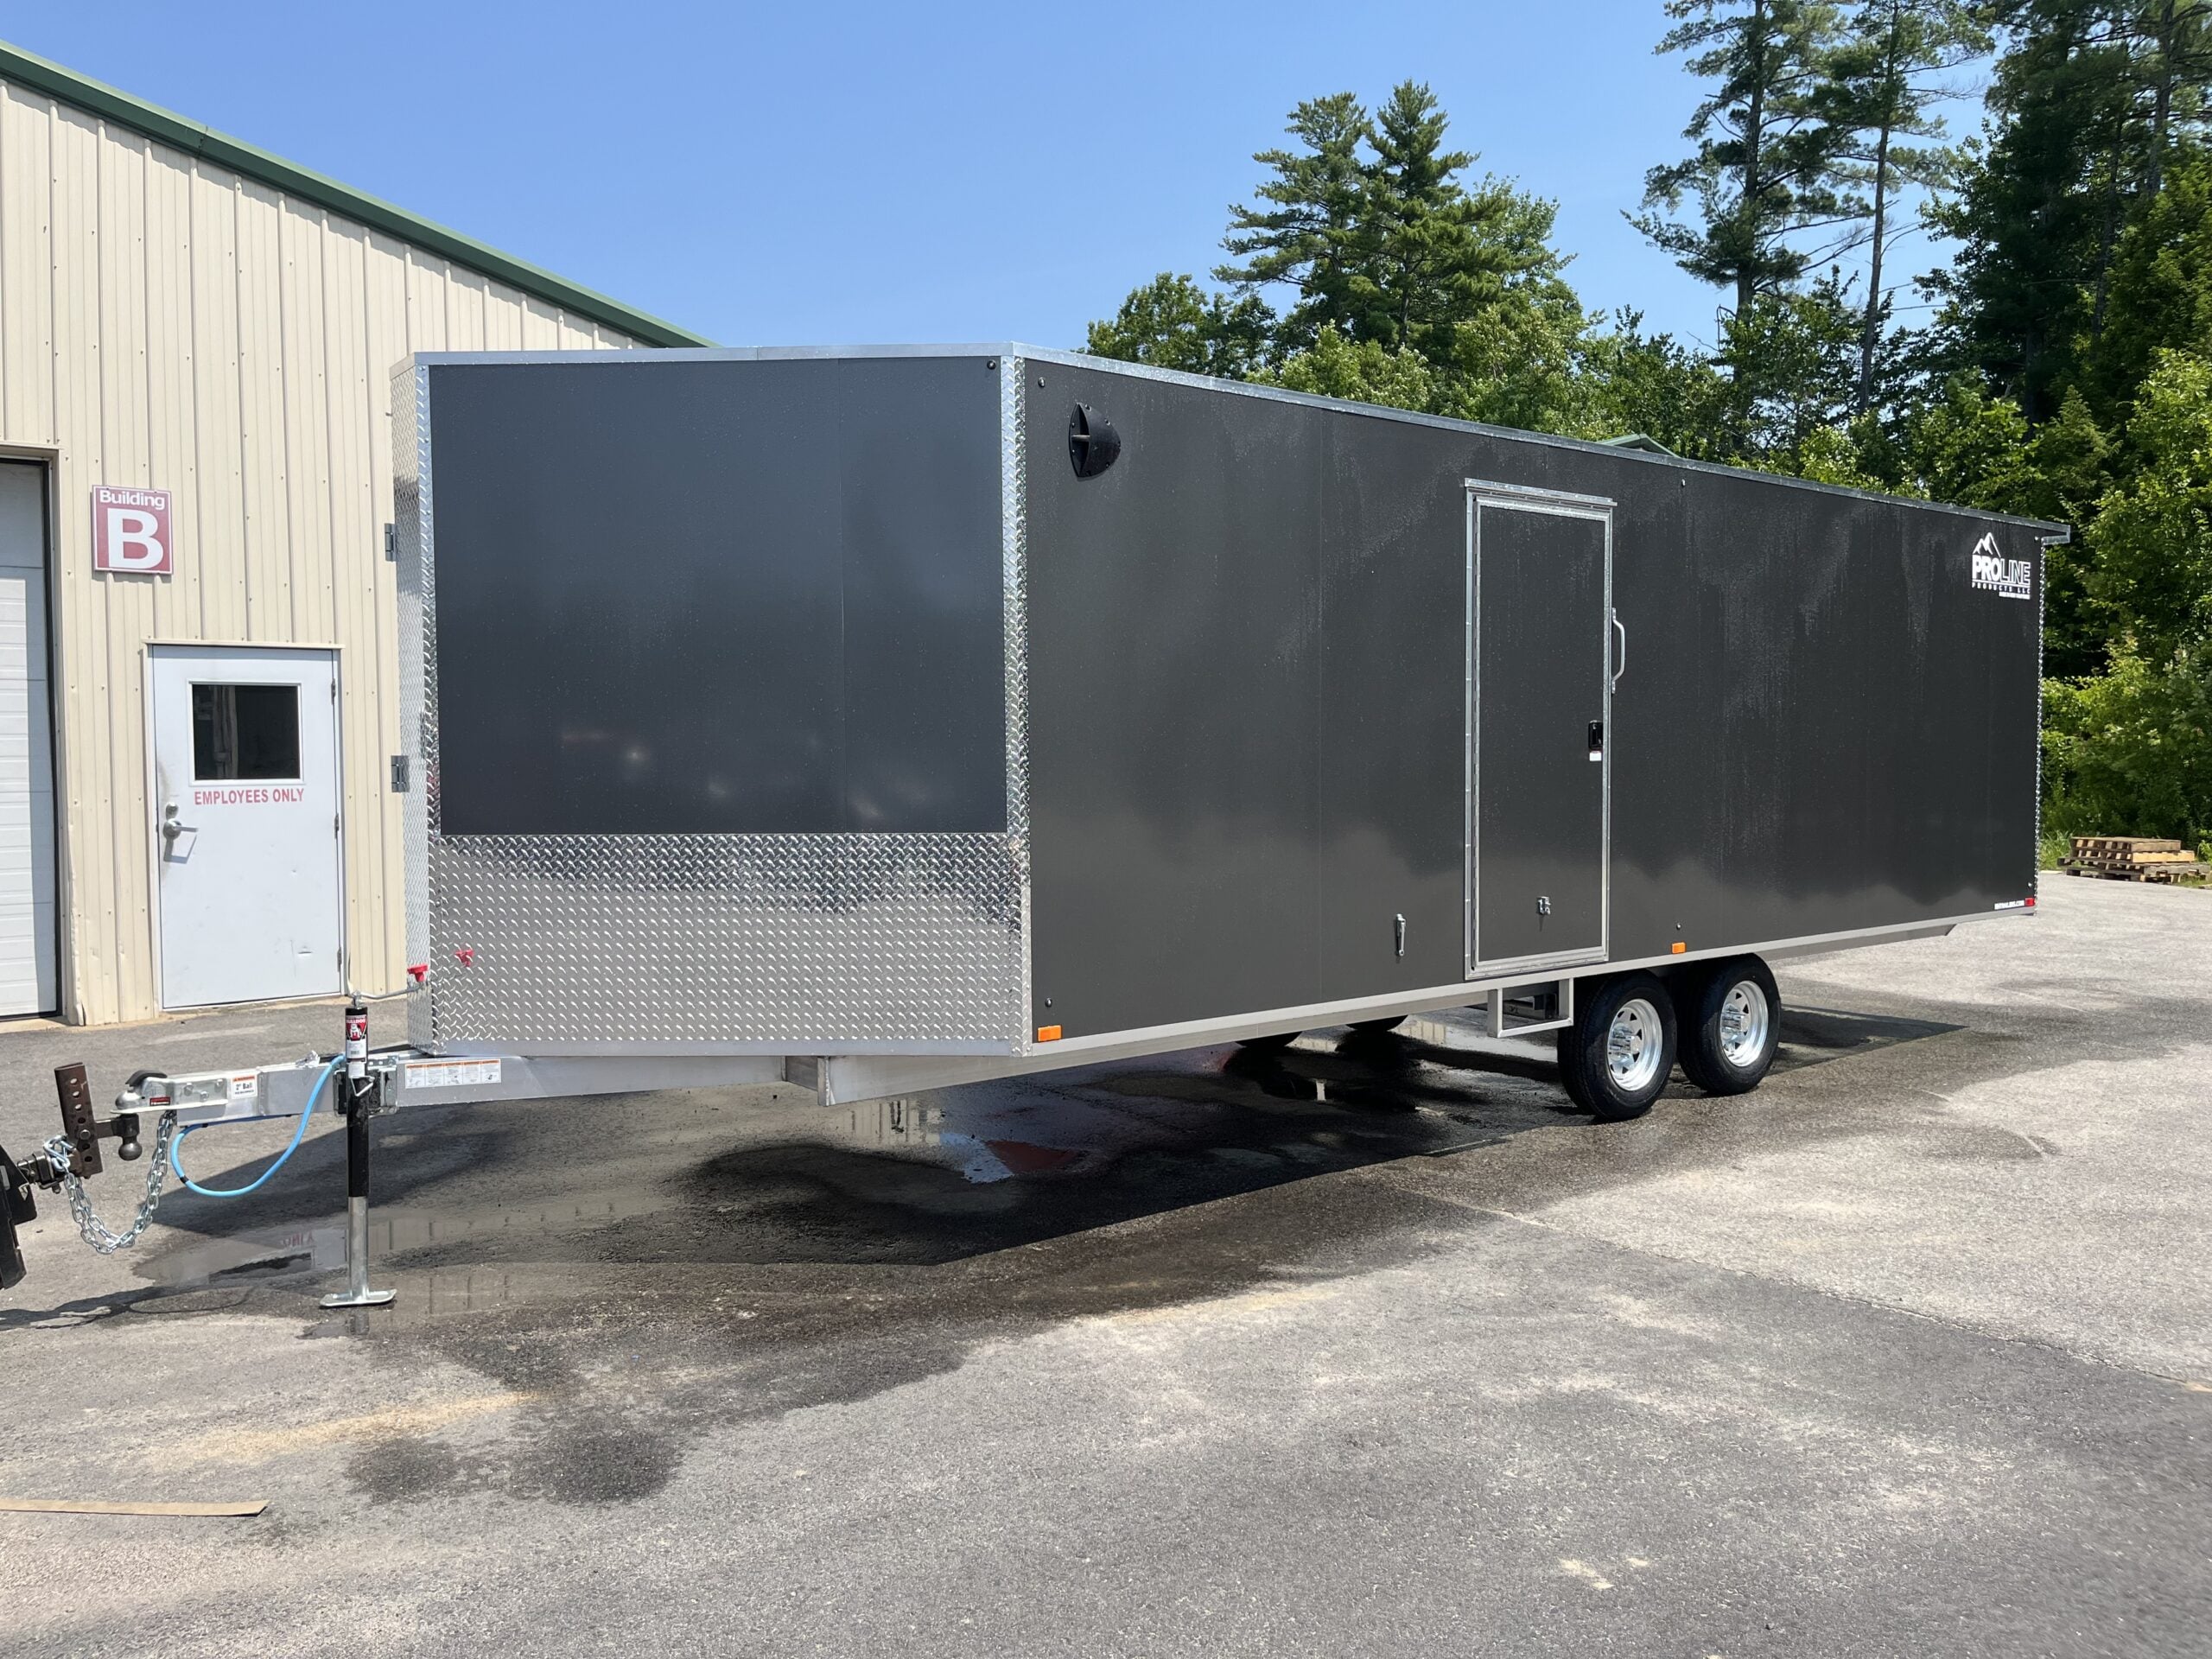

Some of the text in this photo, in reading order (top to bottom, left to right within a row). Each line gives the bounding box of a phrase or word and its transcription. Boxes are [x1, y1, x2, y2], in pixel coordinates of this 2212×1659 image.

[99, 490, 165, 510] Building
[107, 508, 163, 569] B
[1972, 554, 2031, 585] PROLINE
[194, 788, 304, 805] EMPLOYEES ONLY
